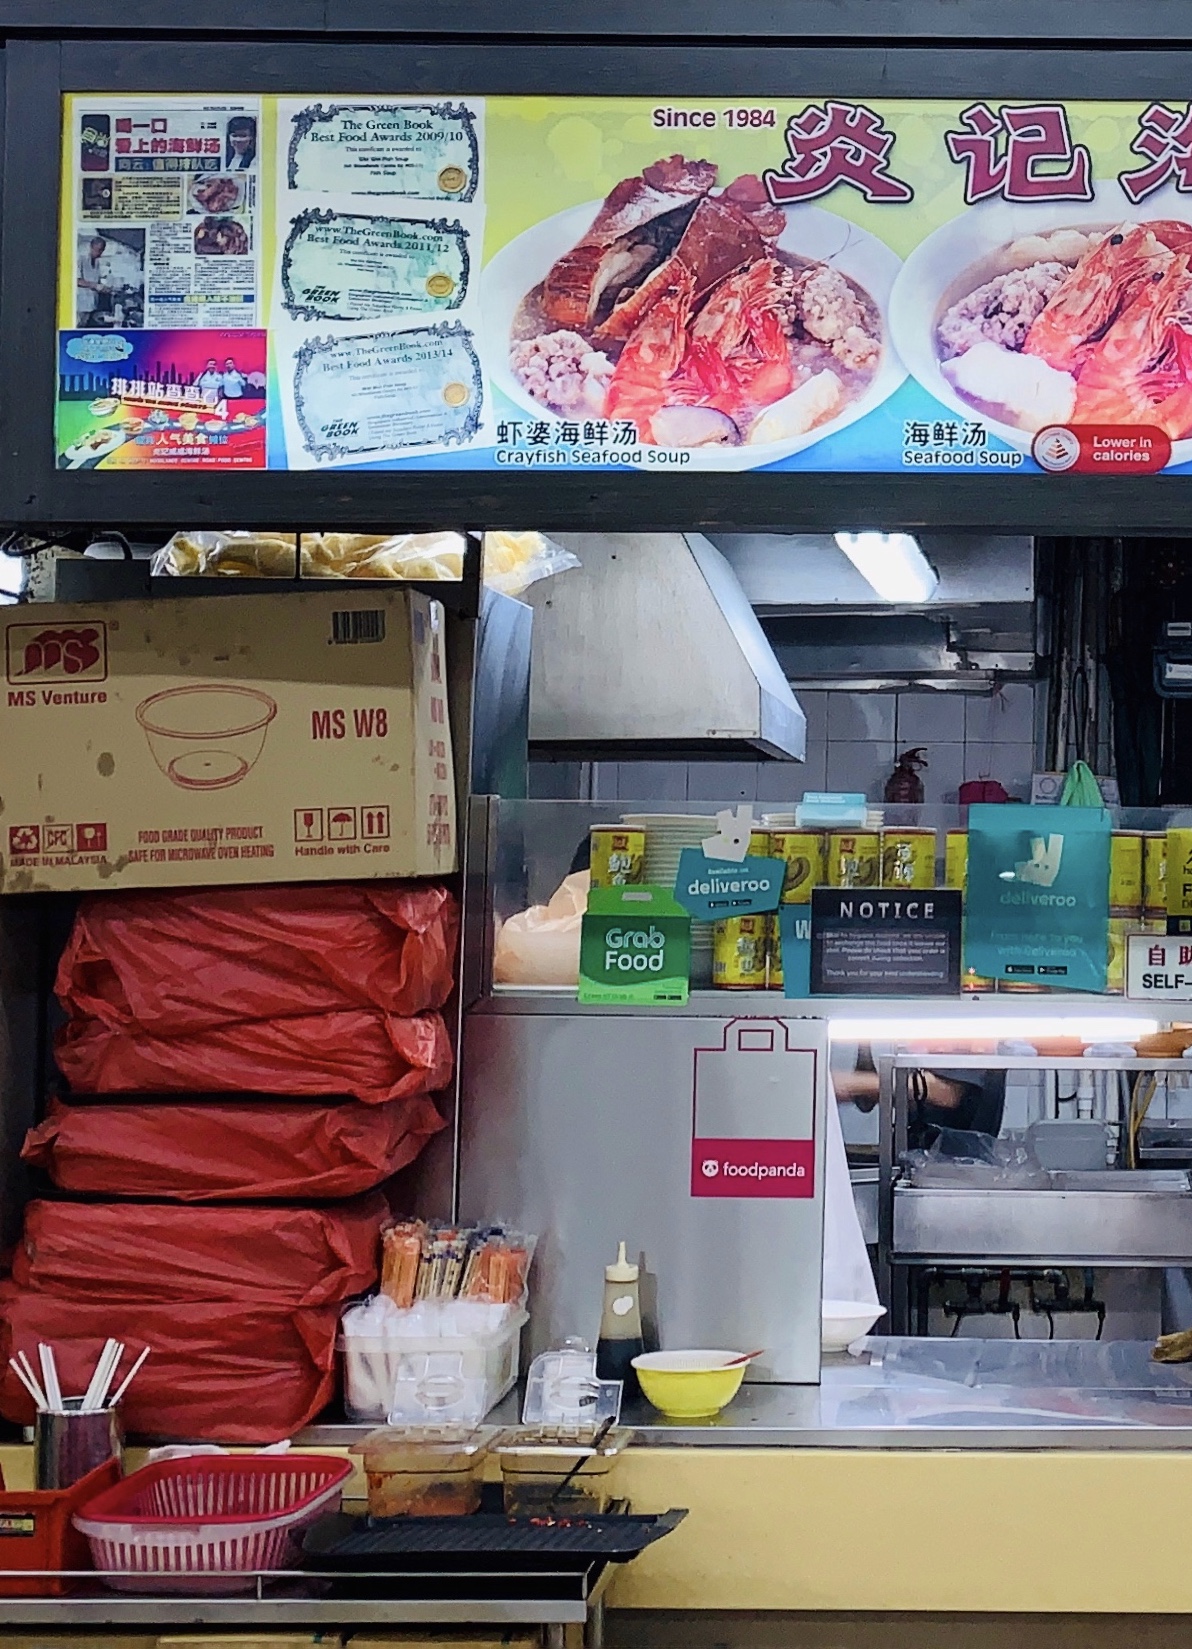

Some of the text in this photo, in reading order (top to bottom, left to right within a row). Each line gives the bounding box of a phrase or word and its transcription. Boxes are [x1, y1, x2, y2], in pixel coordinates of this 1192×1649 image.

[342, 119, 434, 130] The Green Book
[653, 109, 776, 127] Since 1984
[311, 131, 463, 142] Best Food Awards 2009/10
[307, 233, 450, 253] Best Food Awards 2011/12
[302, 288, 341, 297] GREEN
[305, 295, 341, 304] BOOK
[323, 362, 344, 372] Best
[347, 359, 371, 370] Food
[375, 355, 413, 367] Awards
[321, 422, 358, 432] GREEN
[326, 428, 360, 438] BOOK
[497, 420, 637, 446] 虾婆海鲜汤
[904, 421, 986, 447] 海鲜汤
[1093, 436, 1152, 448] Lower in
[496, 449, 690, 465] Crayfish Seafood Soup
[904, 450, 1022, 466] Seafood Soup
[1093, 451, 1150, 461] calories
[8, 690, 107, 707] MS Venture
[311, 708, 388, 739] MS W8
[138, 826, 264, 844] FOOD GRADE QUALITY PRODUCT
[128, 844, 274, 863] SAFE FOR MICROWAVE OVEN HEATING
[295, 843, 391, 856] Handle with Care
[10, 857, 39, 867] MADE
[55, 855, 107, 866] MALAYSIA
[688, 878, 770, 895] deliveroo
[1000, 891, 1077, 907] deliveroo
[840, 901, 935, 919] NOTICE
[605, 926, 665, 949] Grab
[605, 950, 664, 971] Food
[722, 1161, 806, 1181] foodpanda
